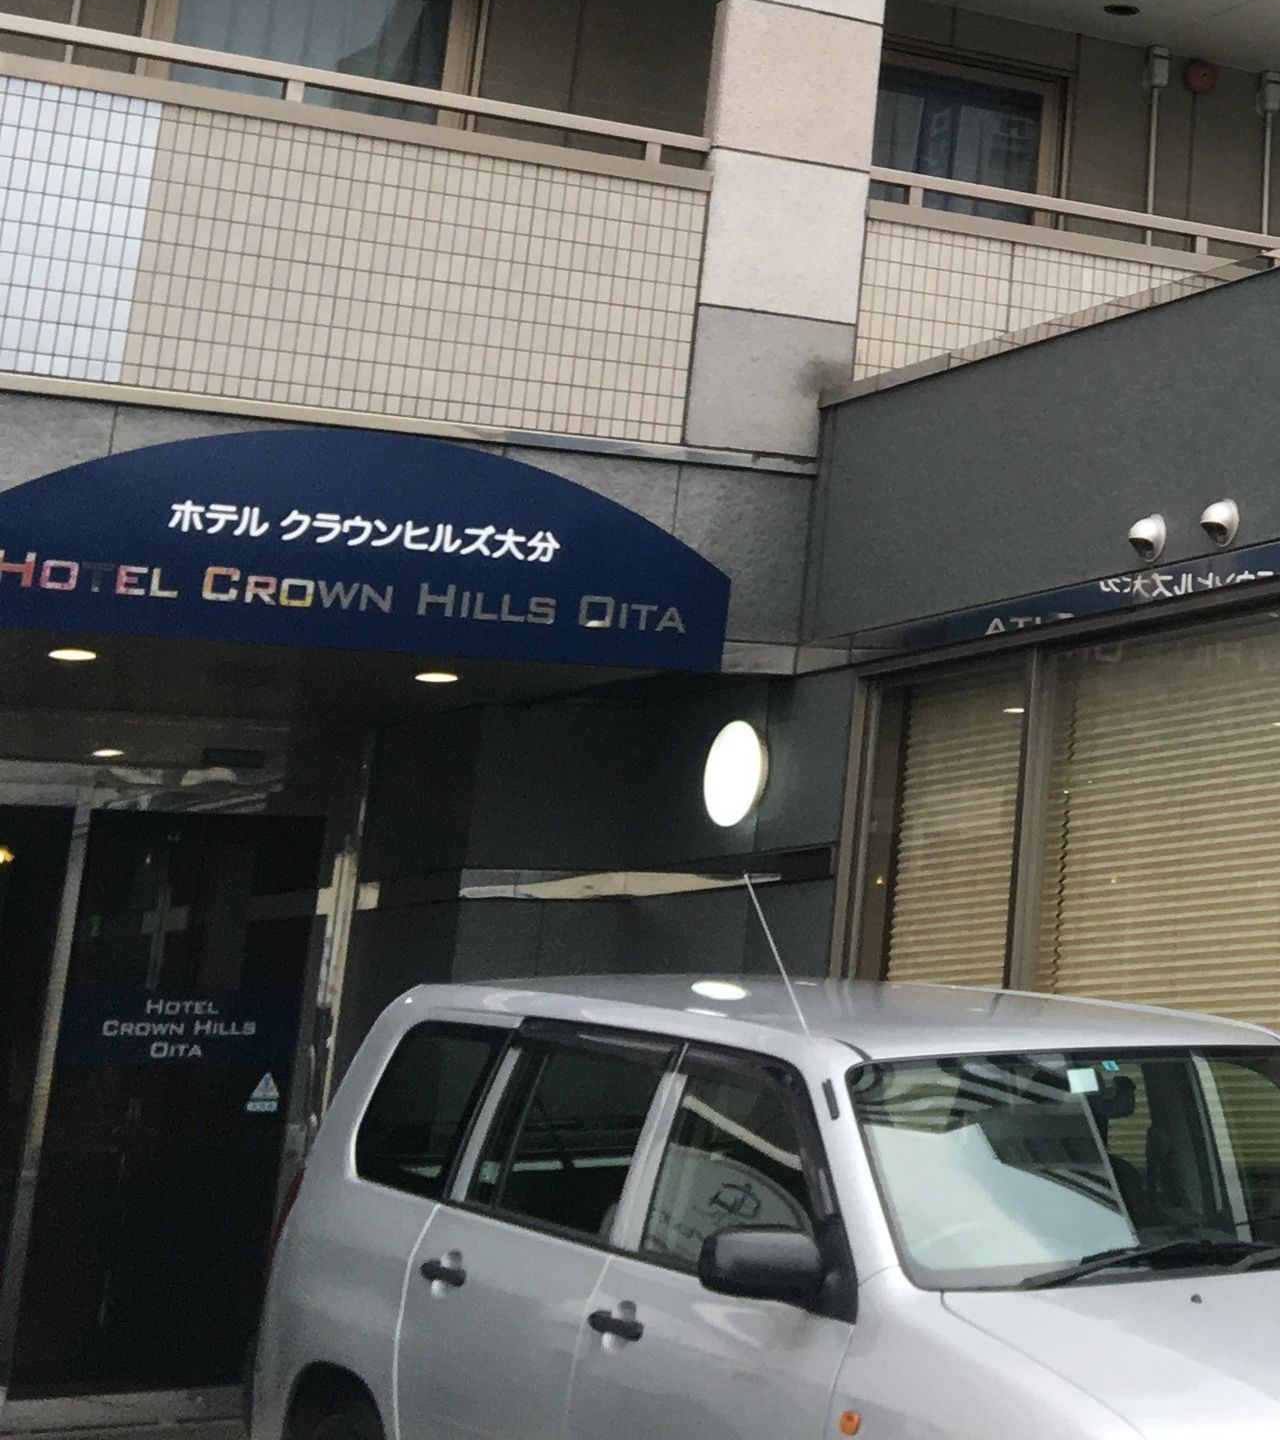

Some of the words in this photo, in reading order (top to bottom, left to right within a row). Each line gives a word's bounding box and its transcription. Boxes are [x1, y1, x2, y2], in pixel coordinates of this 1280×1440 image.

[167, 499, 270, 538] ホテル
[279, 509, 561, 563] クラウンヒルズ大分
[201, 565, 394, 614] CROWN
[416, 582, 557, 626] HILLS
[577, 594, 687, 635] OITA
[145, 998, 220, 1016] HOTEL
[101, 1019, 185, 1037] CROWN
[192, 1019, 258, 1036] HILLS
[149, 1040, 203, 1059] OITA
